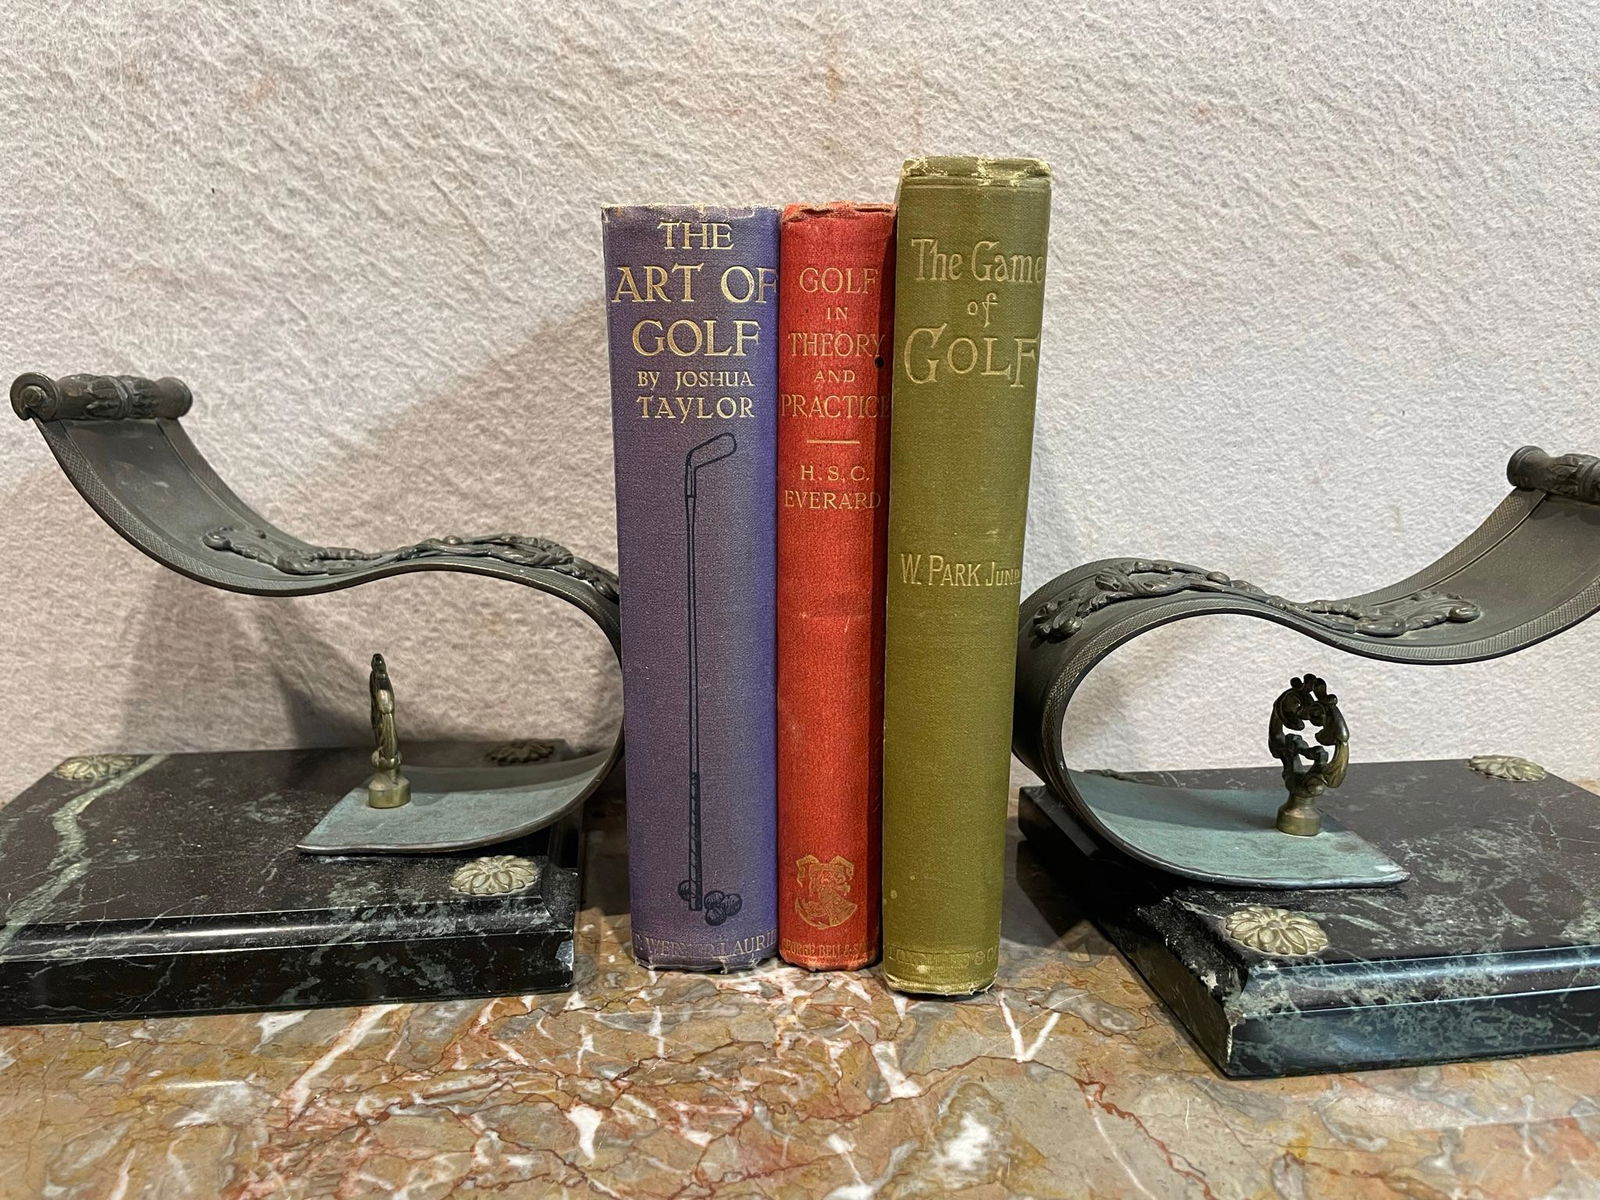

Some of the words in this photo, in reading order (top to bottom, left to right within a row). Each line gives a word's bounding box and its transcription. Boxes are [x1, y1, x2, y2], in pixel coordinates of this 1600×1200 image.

[657, 220, 734, 250] THE
[911, 238, 963, 281] The
[970, 240, 1044, 283] Game
[611, 263, 704, 302] ART
[721, 266, 778, 304] OF
[800, 267, 880, 294] GOLF
[826, 306, 849, 321] IN
[967, 292, 998, 328] of
[632, 319, 761, 357] GOLF
[788, 333, 886, 358] THEORY
[903, 322, 1040, 388] GOLF
[675, 370, 755, 391] JOSHUA
[814, 369, 856, 384] AND
[637, 395, 755, 424] TAYLOR
[784, 489, 881, 510] EVERARD
[928, 554, 982, 587] PARK
